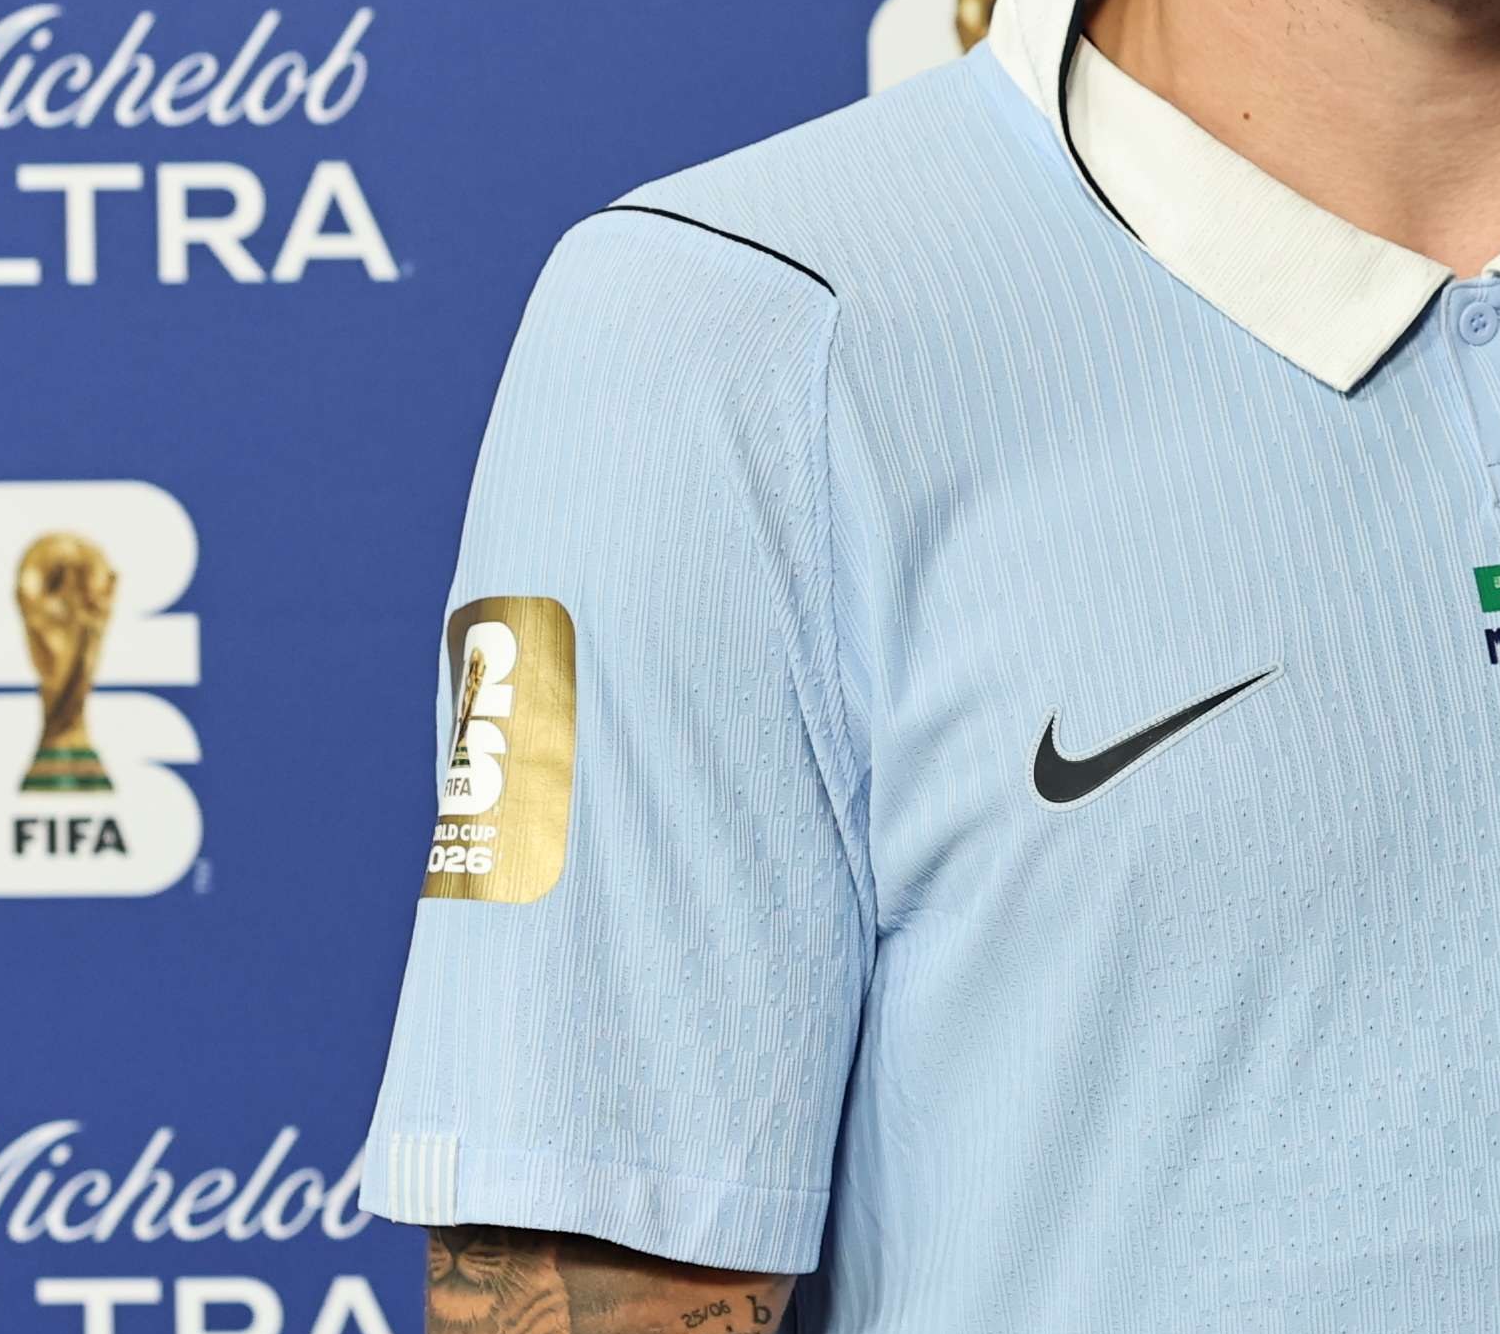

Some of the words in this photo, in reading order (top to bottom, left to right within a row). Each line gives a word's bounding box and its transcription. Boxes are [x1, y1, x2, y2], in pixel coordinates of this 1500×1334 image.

[14, 818, 126, 854] FIFA
[460, 823, 497, 842] CUP
[427, 845, 494, 875] 026
